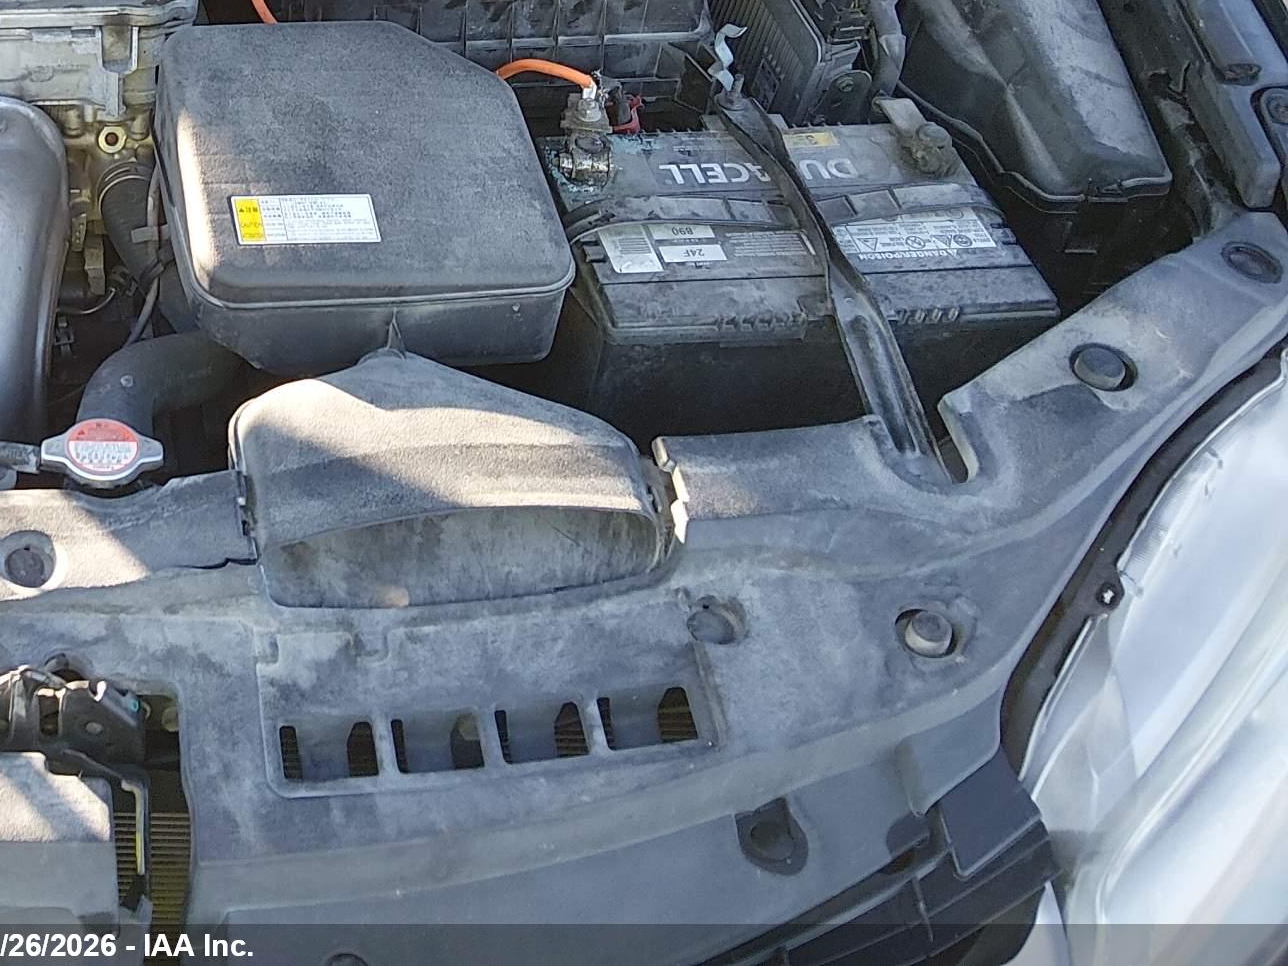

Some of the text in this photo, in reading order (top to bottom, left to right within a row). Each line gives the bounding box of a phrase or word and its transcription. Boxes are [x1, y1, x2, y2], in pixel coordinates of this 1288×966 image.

[658, 157, 859, 184] DUACELL
[671, 226, 694, 236] B90
[682, 248, 705, 258] 24F
